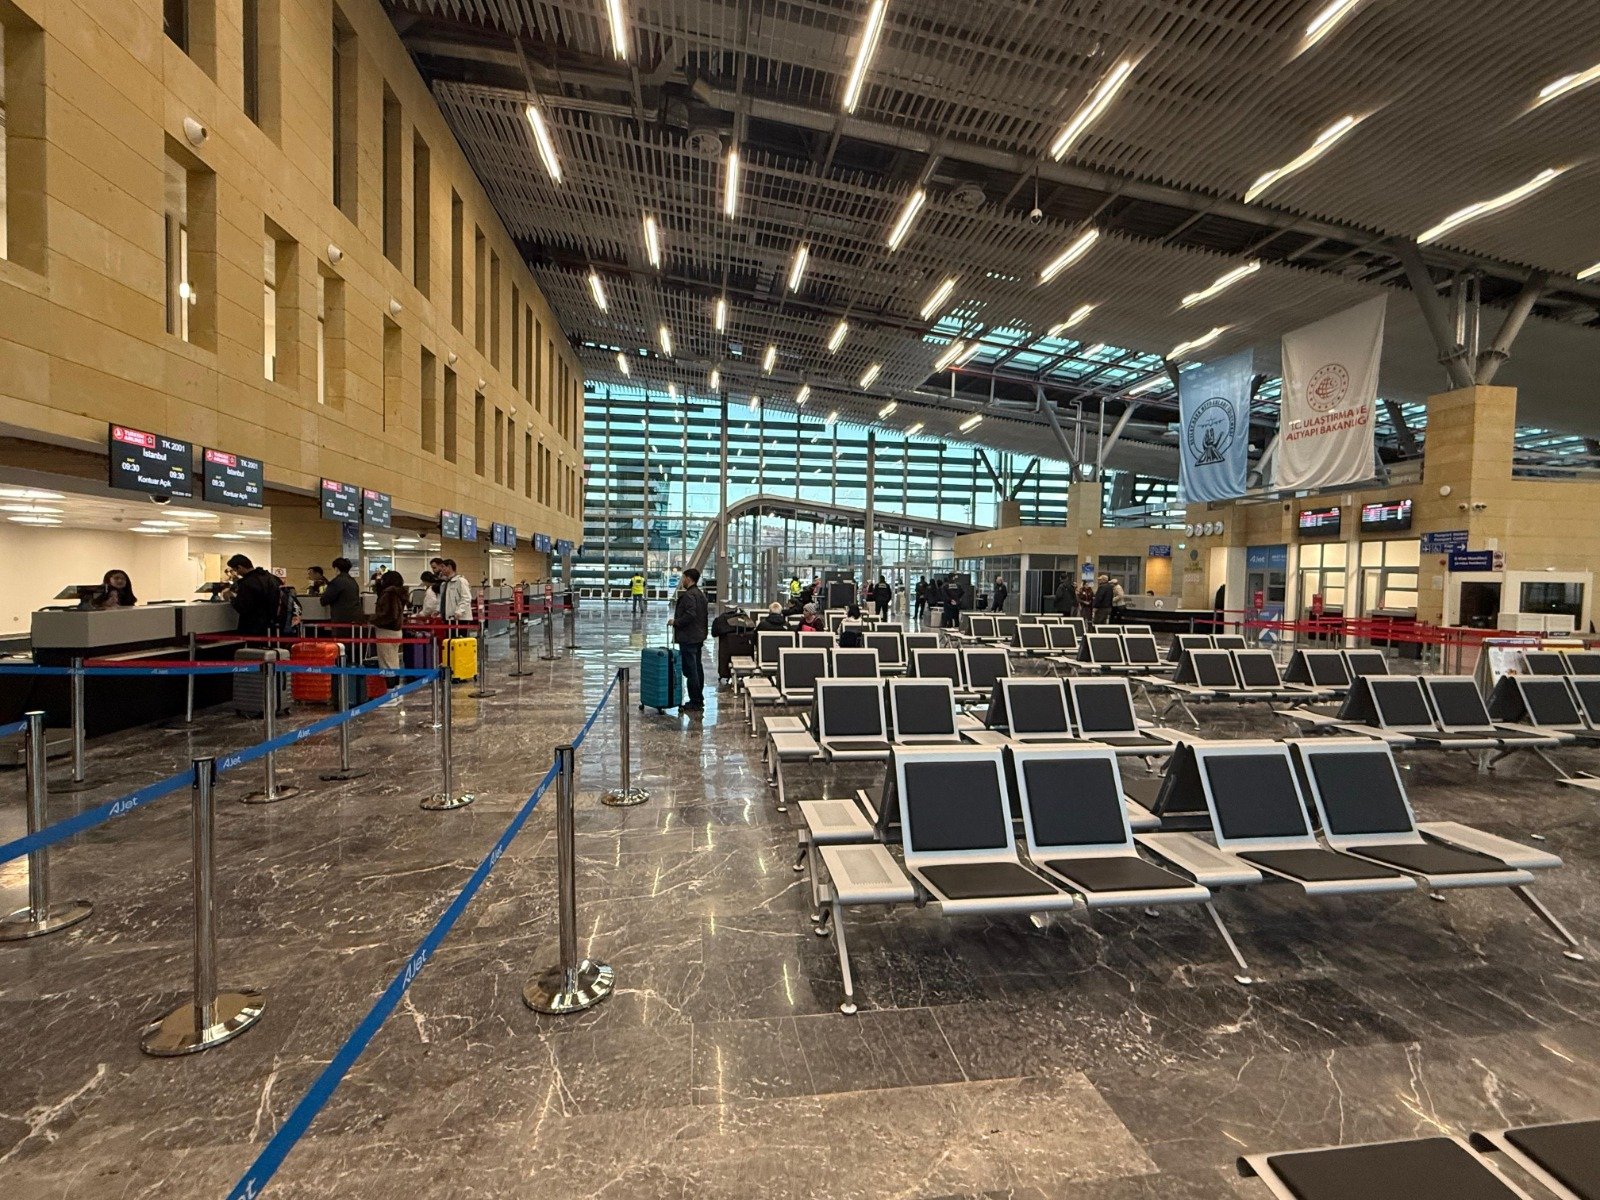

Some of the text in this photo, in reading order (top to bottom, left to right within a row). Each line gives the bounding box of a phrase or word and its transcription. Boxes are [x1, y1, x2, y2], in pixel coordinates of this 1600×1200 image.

[1303, 409, 1354, 428] ULAŞTIRMA
[1286, 427, 1318, 441] ALTYAPI
[161, 440, 185, 452] TK 2001
[143, 447, 167, 461] İstanbul
[121, 462, 140, 472] 09:30
[223, 756, 241, 769] AJet
[109, 797, 138, 815] AJet
[402, 949, 428, 989] AJet
